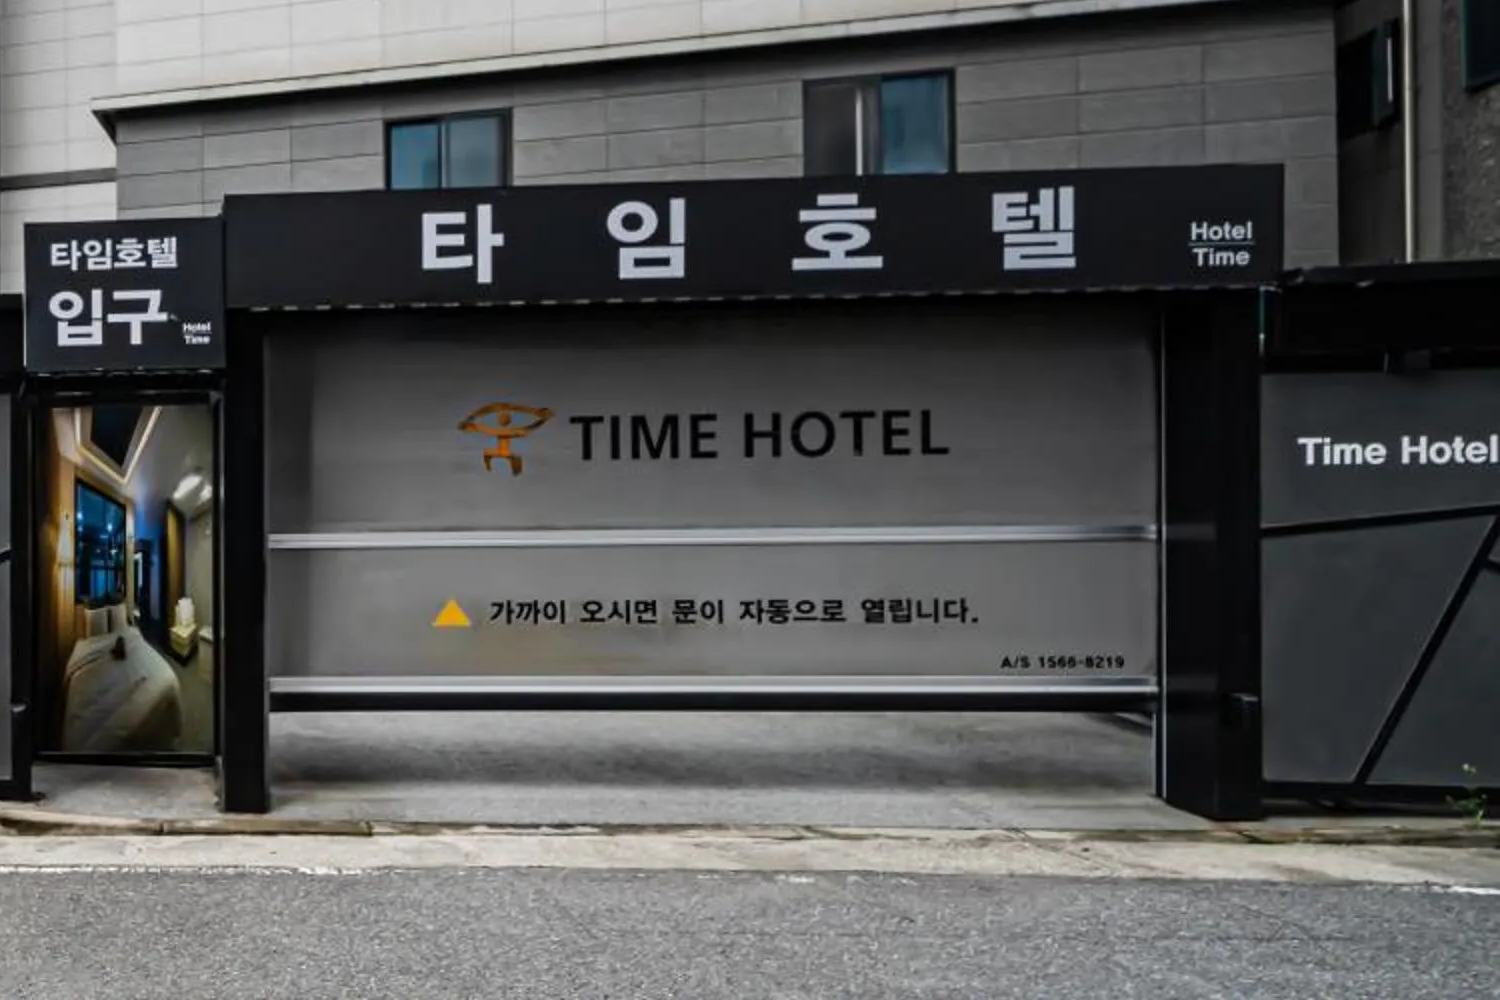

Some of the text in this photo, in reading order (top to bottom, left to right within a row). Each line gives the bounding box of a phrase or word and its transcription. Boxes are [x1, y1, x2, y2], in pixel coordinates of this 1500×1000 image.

[1190, 221, 1253, 241] Hotel
[50, 236, 178, 271] 타임호텔
[1192, 247, 1250, 267] Time
[49, 288, 169, 347] 입구
[182, 321, 212, 332] Hotel
[183, 334, 211, 345] Time
[569, 409, 950, 461] TIME HOTEL
[1297, 434, 1499, 465] Time Hotel
[490, 598, 980, 625] 가까이 오시면 문이 자동으로 열립니다.
[1000, 655, 1031, 669] A/S
